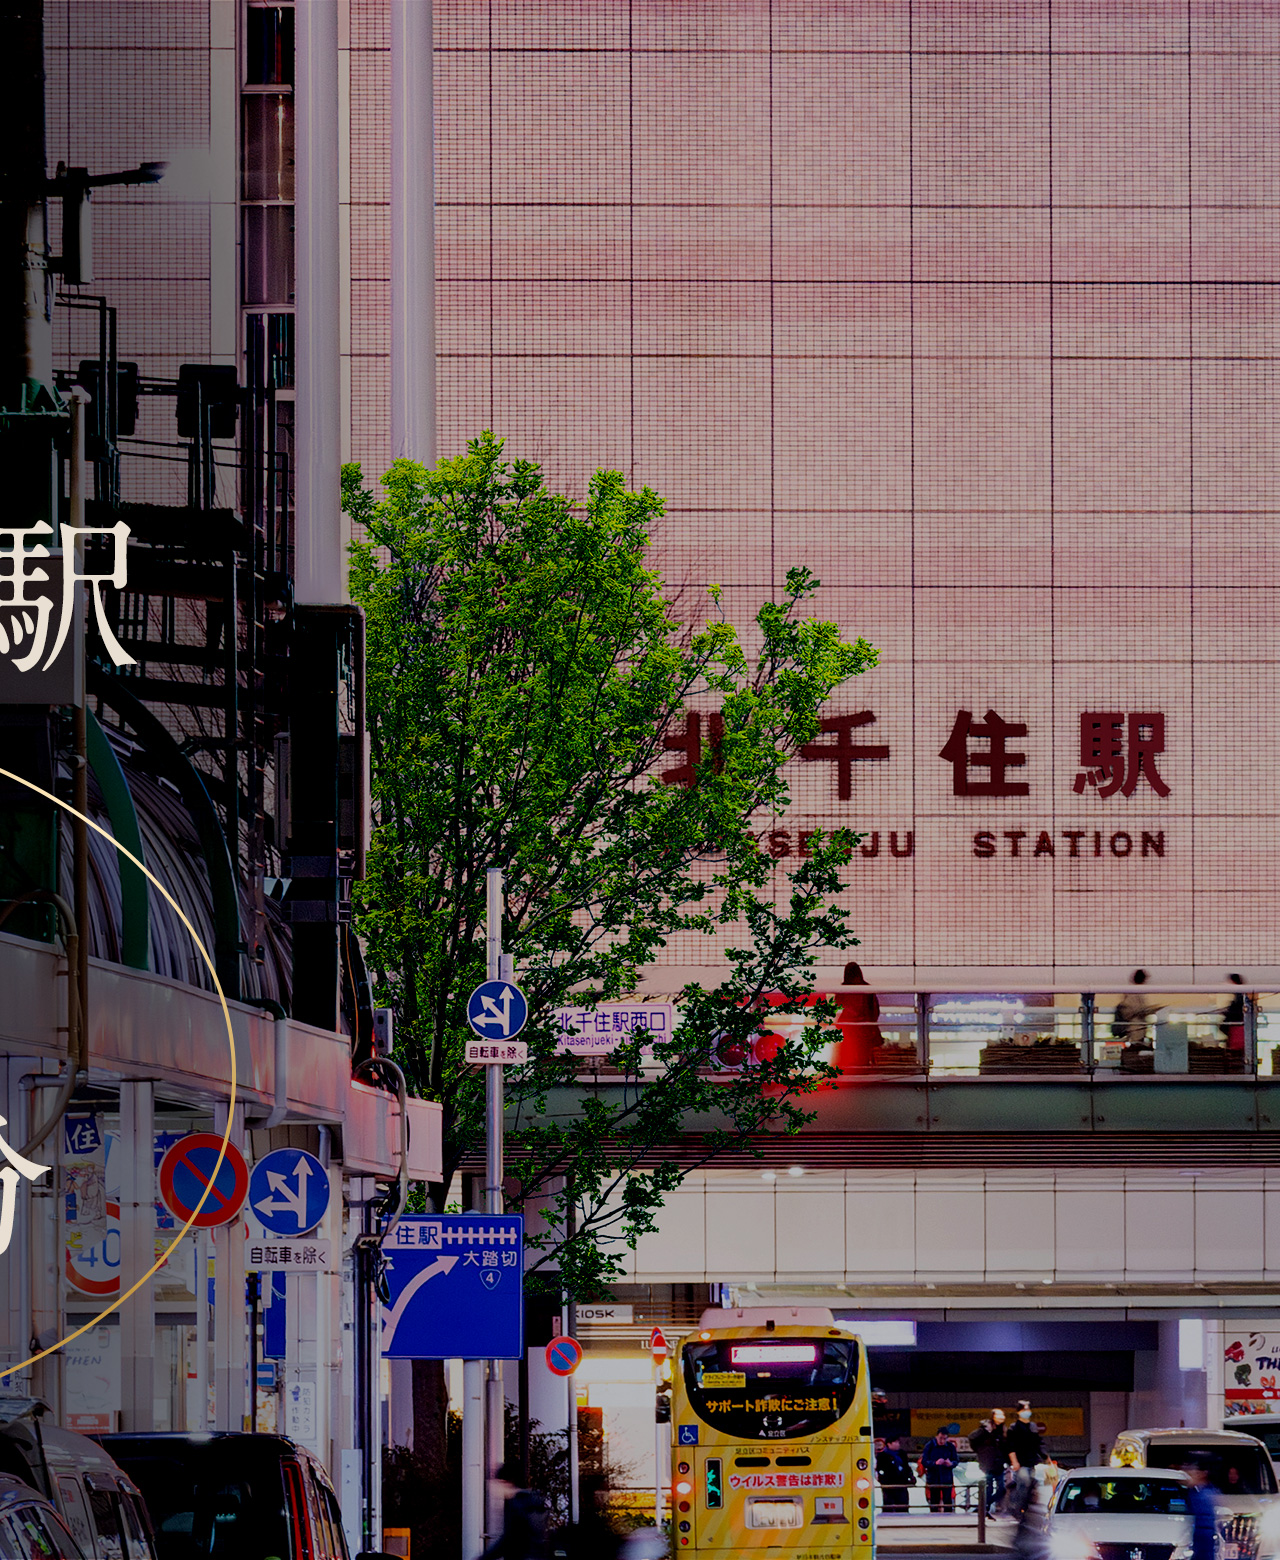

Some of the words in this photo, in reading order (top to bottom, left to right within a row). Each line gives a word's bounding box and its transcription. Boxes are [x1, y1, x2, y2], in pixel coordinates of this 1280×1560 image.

[661, 709, 1172, 802] 北千住駅
[973, 830, 1166, 858] STATION
[557, 1011, 666, 1033] 北千住駅西口
[469, 1046, 524, 1060] 自転車を除く
[387, 1225, 439, 1245] 住駅
[251, 1246, 326, 1264] 自転車を除く
[462, 1250, 518, 1267] 大踏切
[486, 1272, 494, 1284] 4
